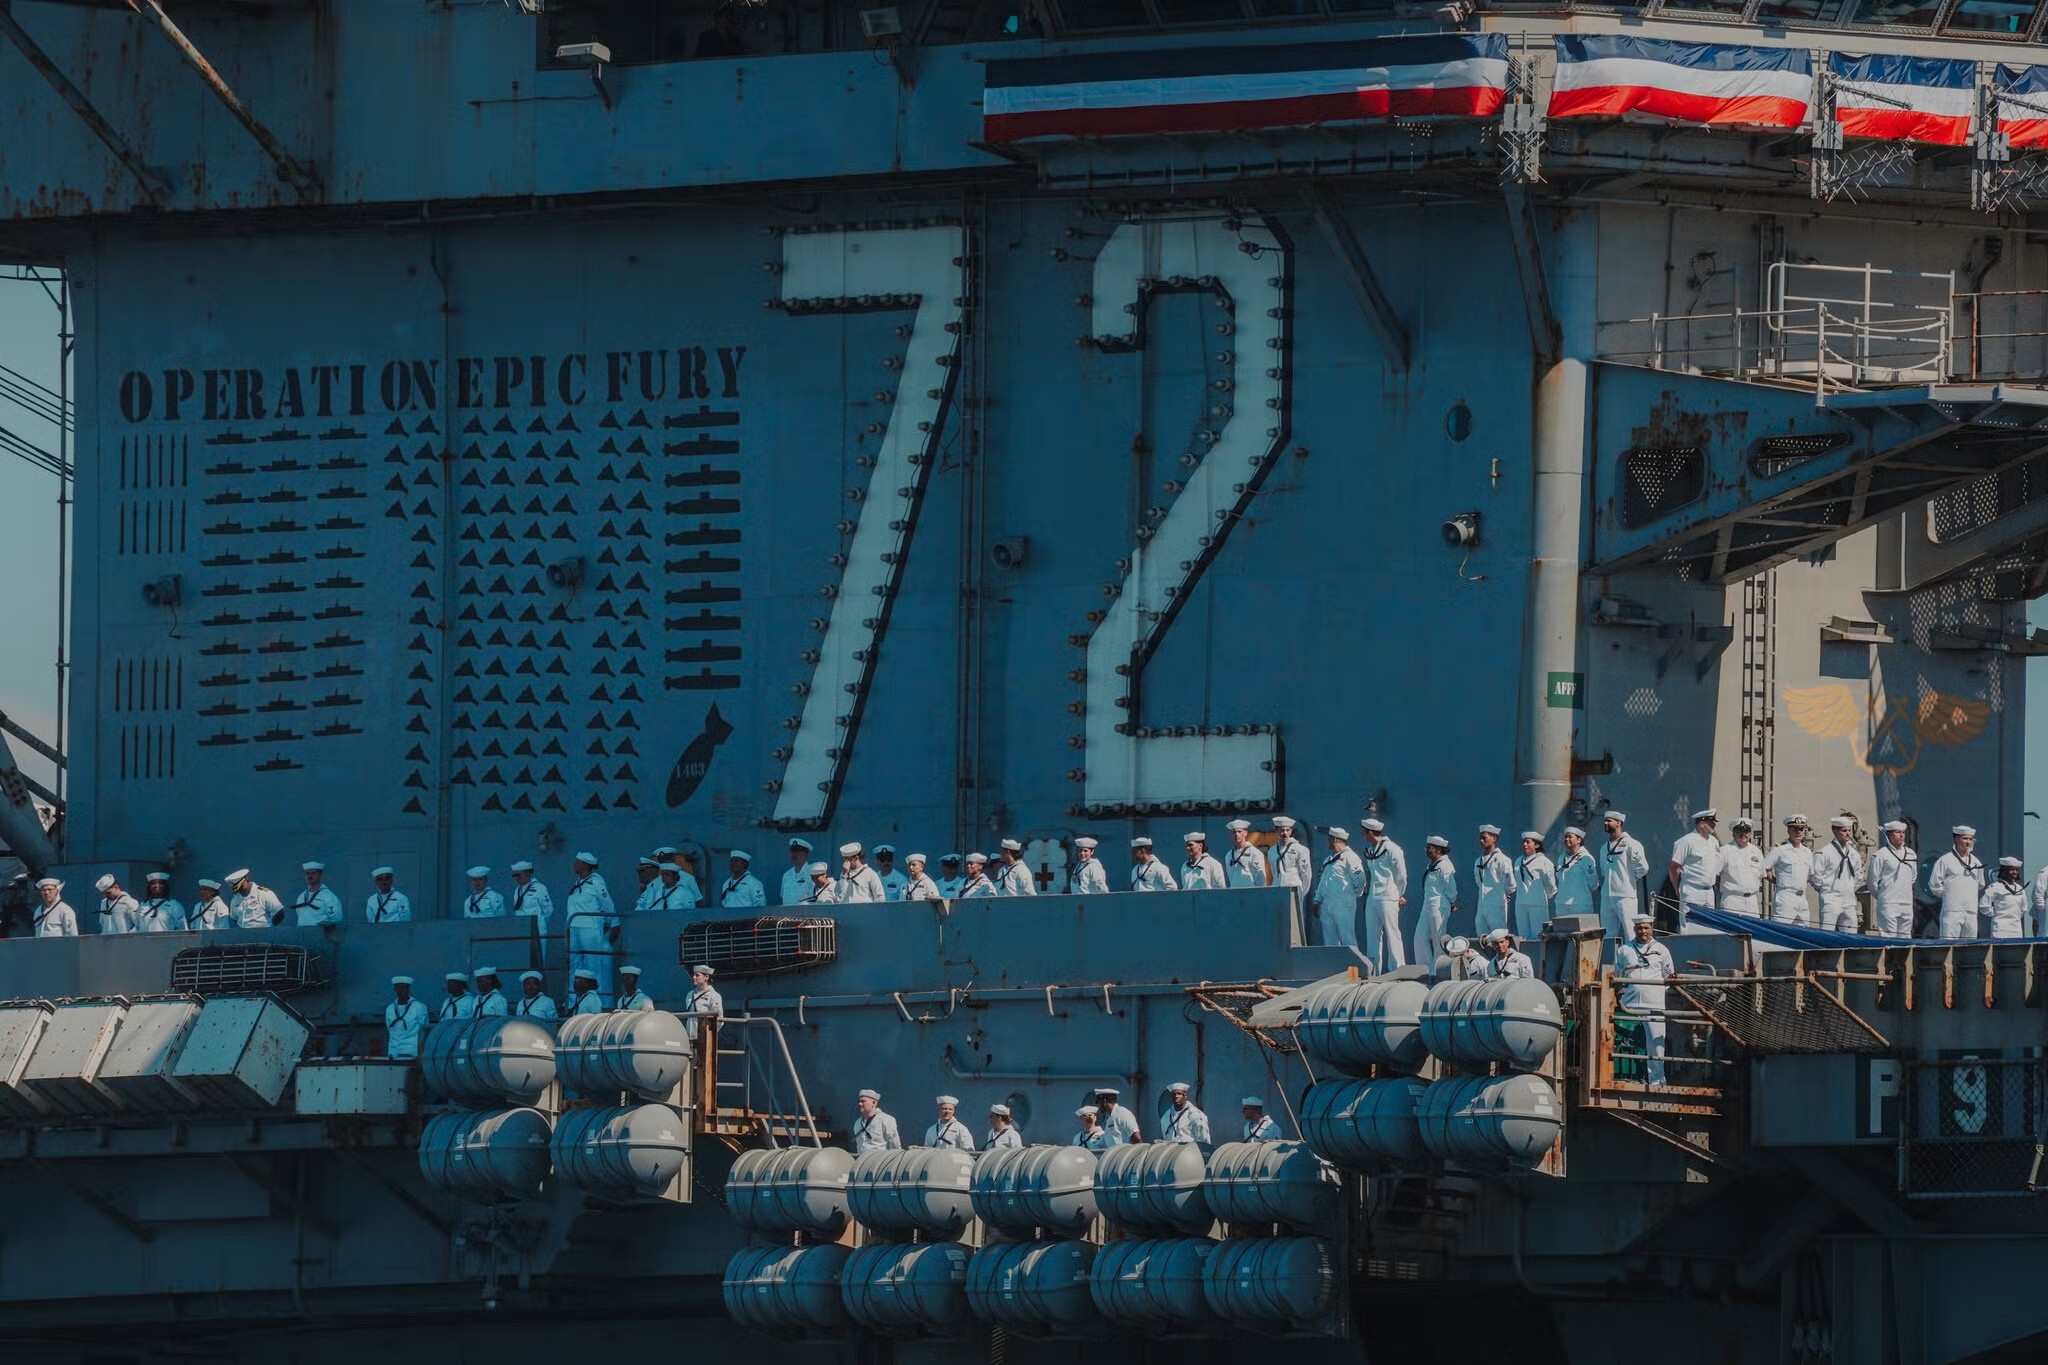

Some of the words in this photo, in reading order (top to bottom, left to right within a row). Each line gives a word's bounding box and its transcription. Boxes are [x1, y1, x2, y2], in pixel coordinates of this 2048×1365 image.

[120, 359, 437, 423] OPERATION
[457, 354, 587, 408] EPIC
[606, 346, 746, 402] FURY
[774, 210, 1294, 826] 72
[1952, 1055, 1988, 1134] 9
